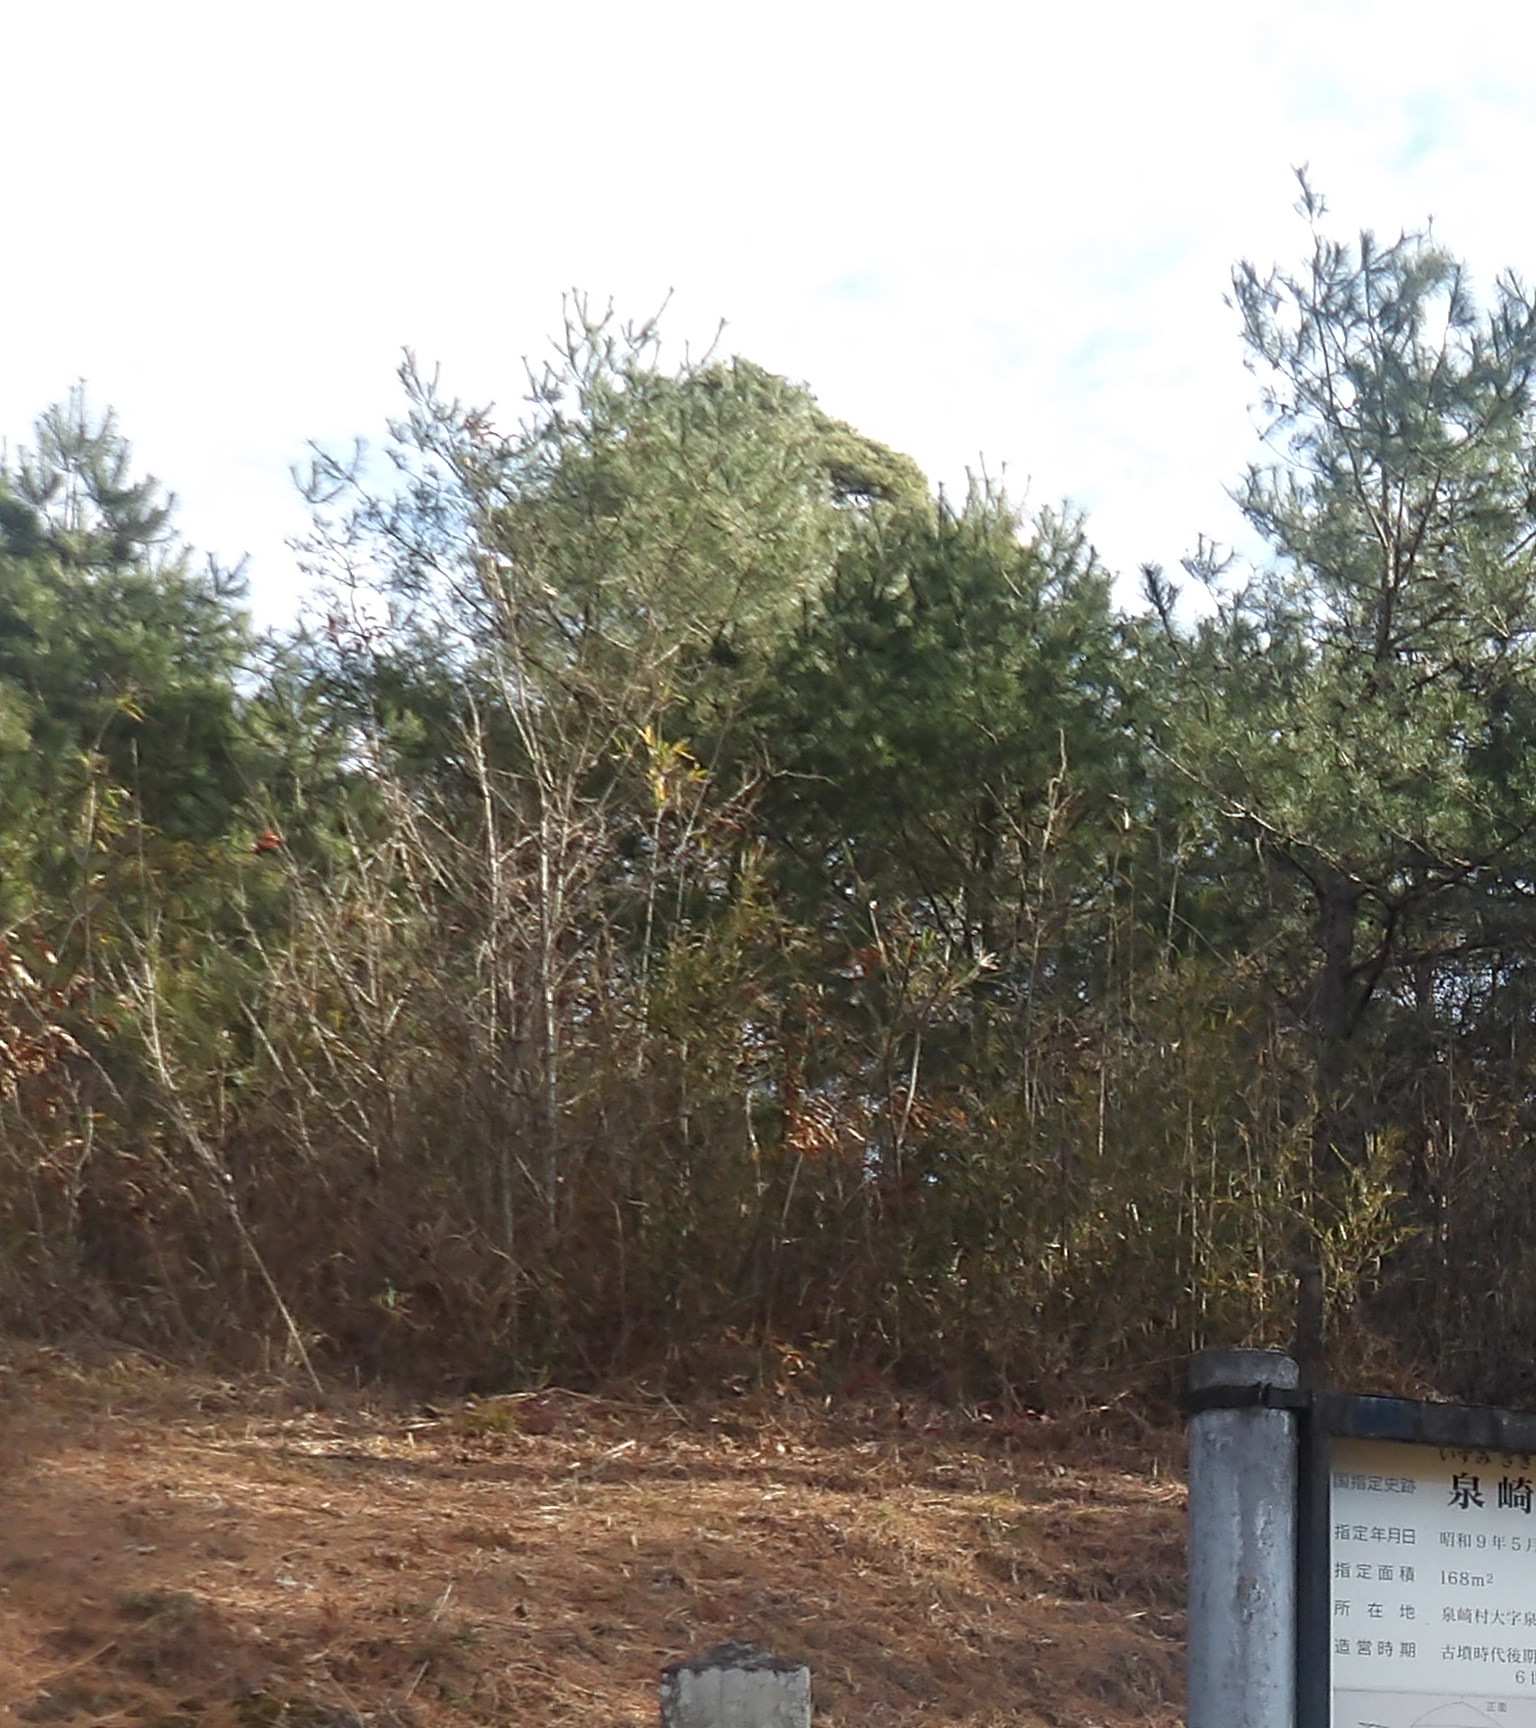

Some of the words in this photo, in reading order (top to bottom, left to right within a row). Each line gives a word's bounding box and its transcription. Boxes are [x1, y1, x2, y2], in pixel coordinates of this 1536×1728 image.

[1333, 1472, 1417, 1494] 国指定史跡
[1334, 1523, 1416, 1546] 指定年月日
[1334, 1562, 1416, 1583] 指定面積
[1334, 1600, 1416, 1620] 所在地
[1334, 1638, 1417, 1659] 造営時期
